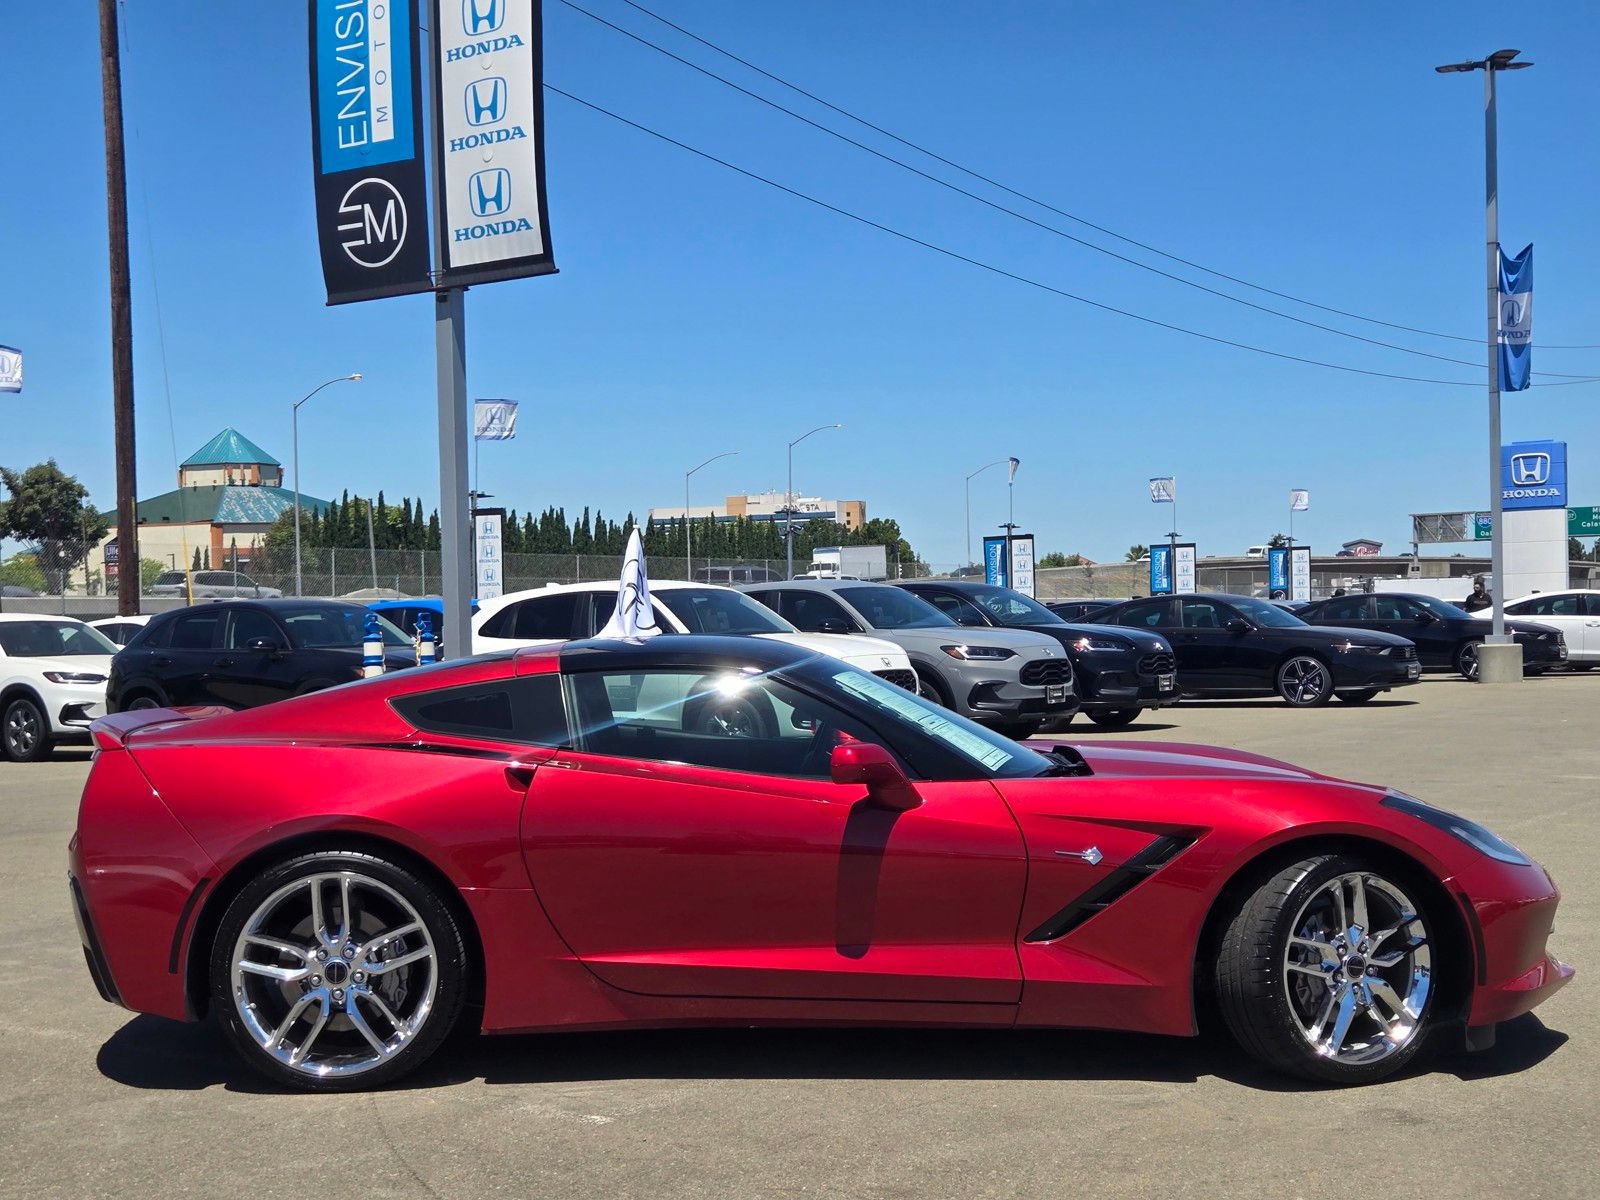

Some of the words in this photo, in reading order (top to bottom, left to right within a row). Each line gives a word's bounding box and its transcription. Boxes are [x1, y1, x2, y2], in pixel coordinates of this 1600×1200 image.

[446, 34, 525, 63] HONDA
[373, 4, 388, 123] MOTO
[450, 125, 527, 153] HONDA
[454, 217, 534, 242] HONDA
[1502, 487, 1561, 499] HONDA
